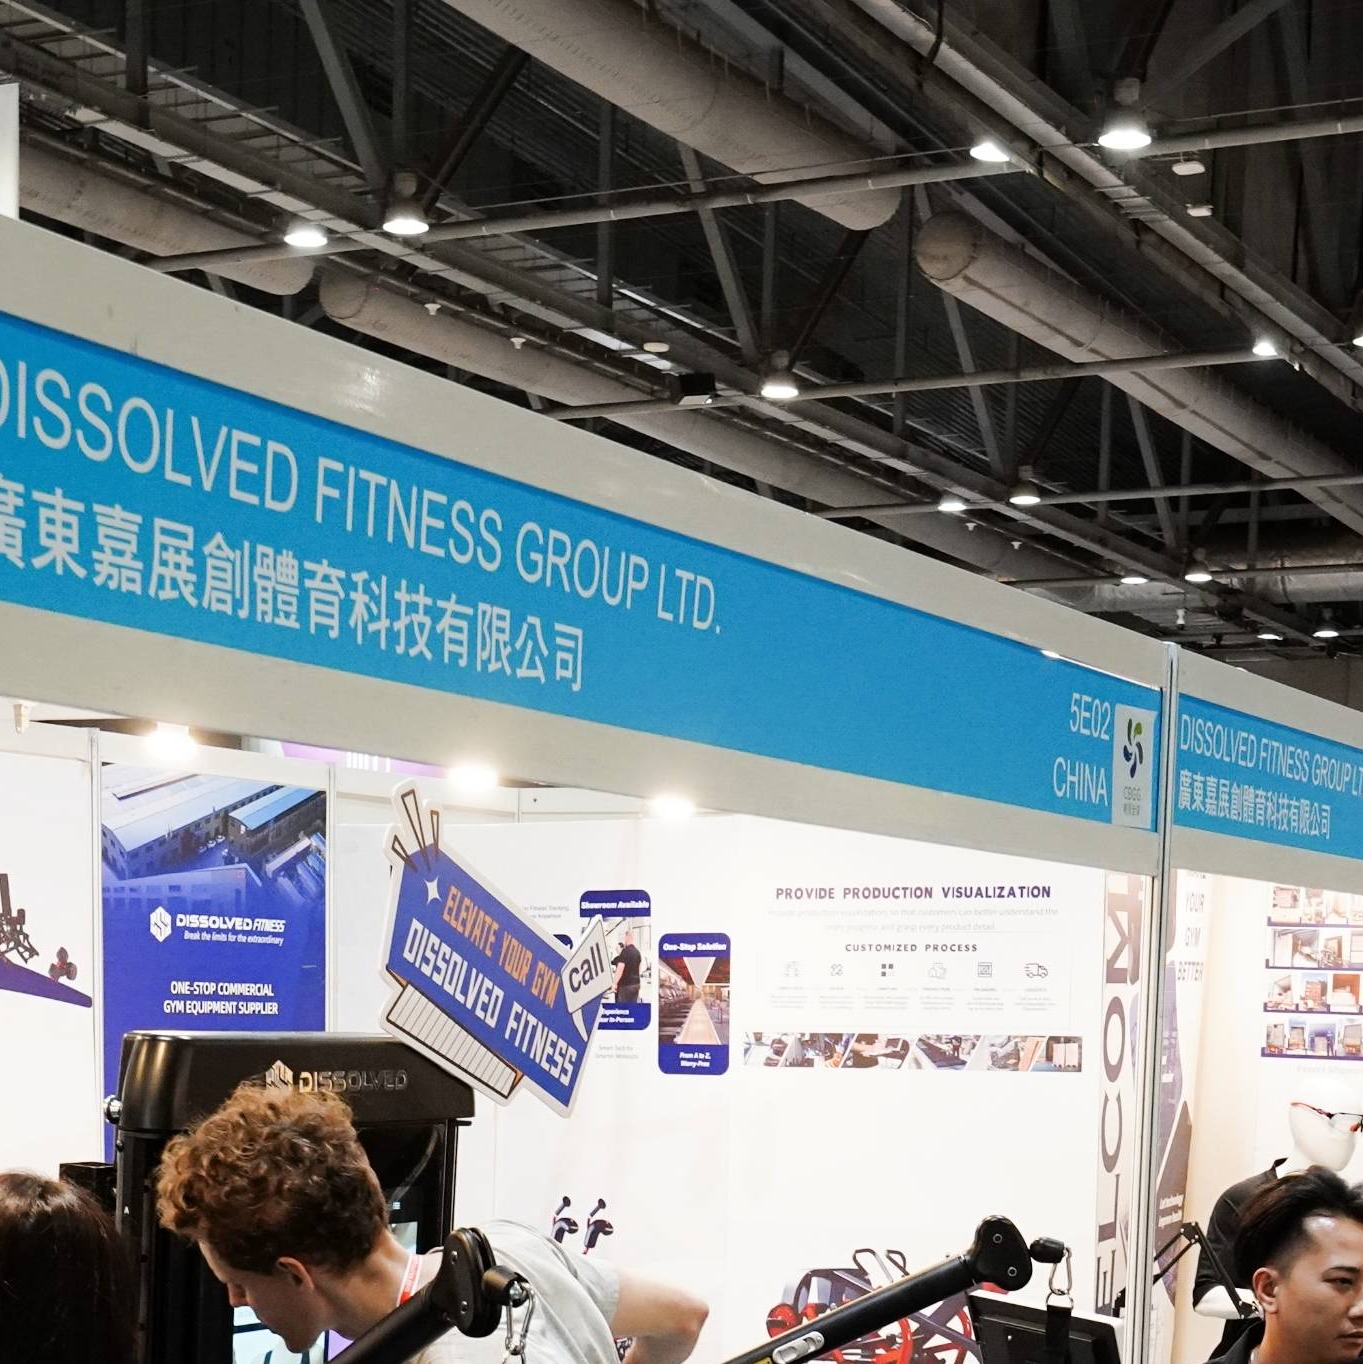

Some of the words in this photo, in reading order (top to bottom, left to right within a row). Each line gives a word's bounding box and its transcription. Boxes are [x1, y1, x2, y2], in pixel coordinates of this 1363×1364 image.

[315, 456, 503, 573] FITNESS
[515, 521, 649, 612] GROUP
[655, 566, 722, 634] LTD.
[1069, 692, 1111, 741] 5E02
[1180, 713, 1258, 769] DISSOLVED
[1258, 737, 1310, 783] FITNESS
[1312, 753, 1352, 793] GROUP
[1052, 756, 1108, 807] CHINA
[775, 886, 835, 900] PROVIDE
[842, 886, 934, 900] PRODUCTION
[941, 885, 1052, 899] VISUALIZATION
[581, 901, 617, 910] Showroom
[618, 900, 650, 909] Available
[176, 913, 252, 931] DISSOLVED
[253, 919, 286, 933] FITNESS
[184, 930, 200, 941] Break
[201, 931, 211, 941] the
[212, 931, 228, 942] limits
[228, 932, 237, 943] for
[237, 932, 247, 943] the
[247, 933, 284, 947] extraordinary
[442, 885, 500, 958] ELEVATE
[498, 931, 533, 986] YOUR
[530, 960, 561, 1009] GYM
[663, 942, 696, 952] One-Stop
[696, 942, 727, 951] Solution
[845, 943, 918, 952] CUSTOMIZED
[925, 943, 979, 952] PROCESS
[568, 942, 605, 993] call
[170, 981, 216, 995] ONE-STOP
[217, 982, 274, 997] COMMERCIAL
[163, 1000, 185, 1014] GYM
[186, 1000, 237, 1016] EQUIPMENT
[238, 1001, 279, 1015] SUPPLIER
[402, 917, 505, 1029] DISSOLVED
[504, 1000, 578, 1087] FITNESS
[299, 1069, 409, 1093] DISSOLVED
